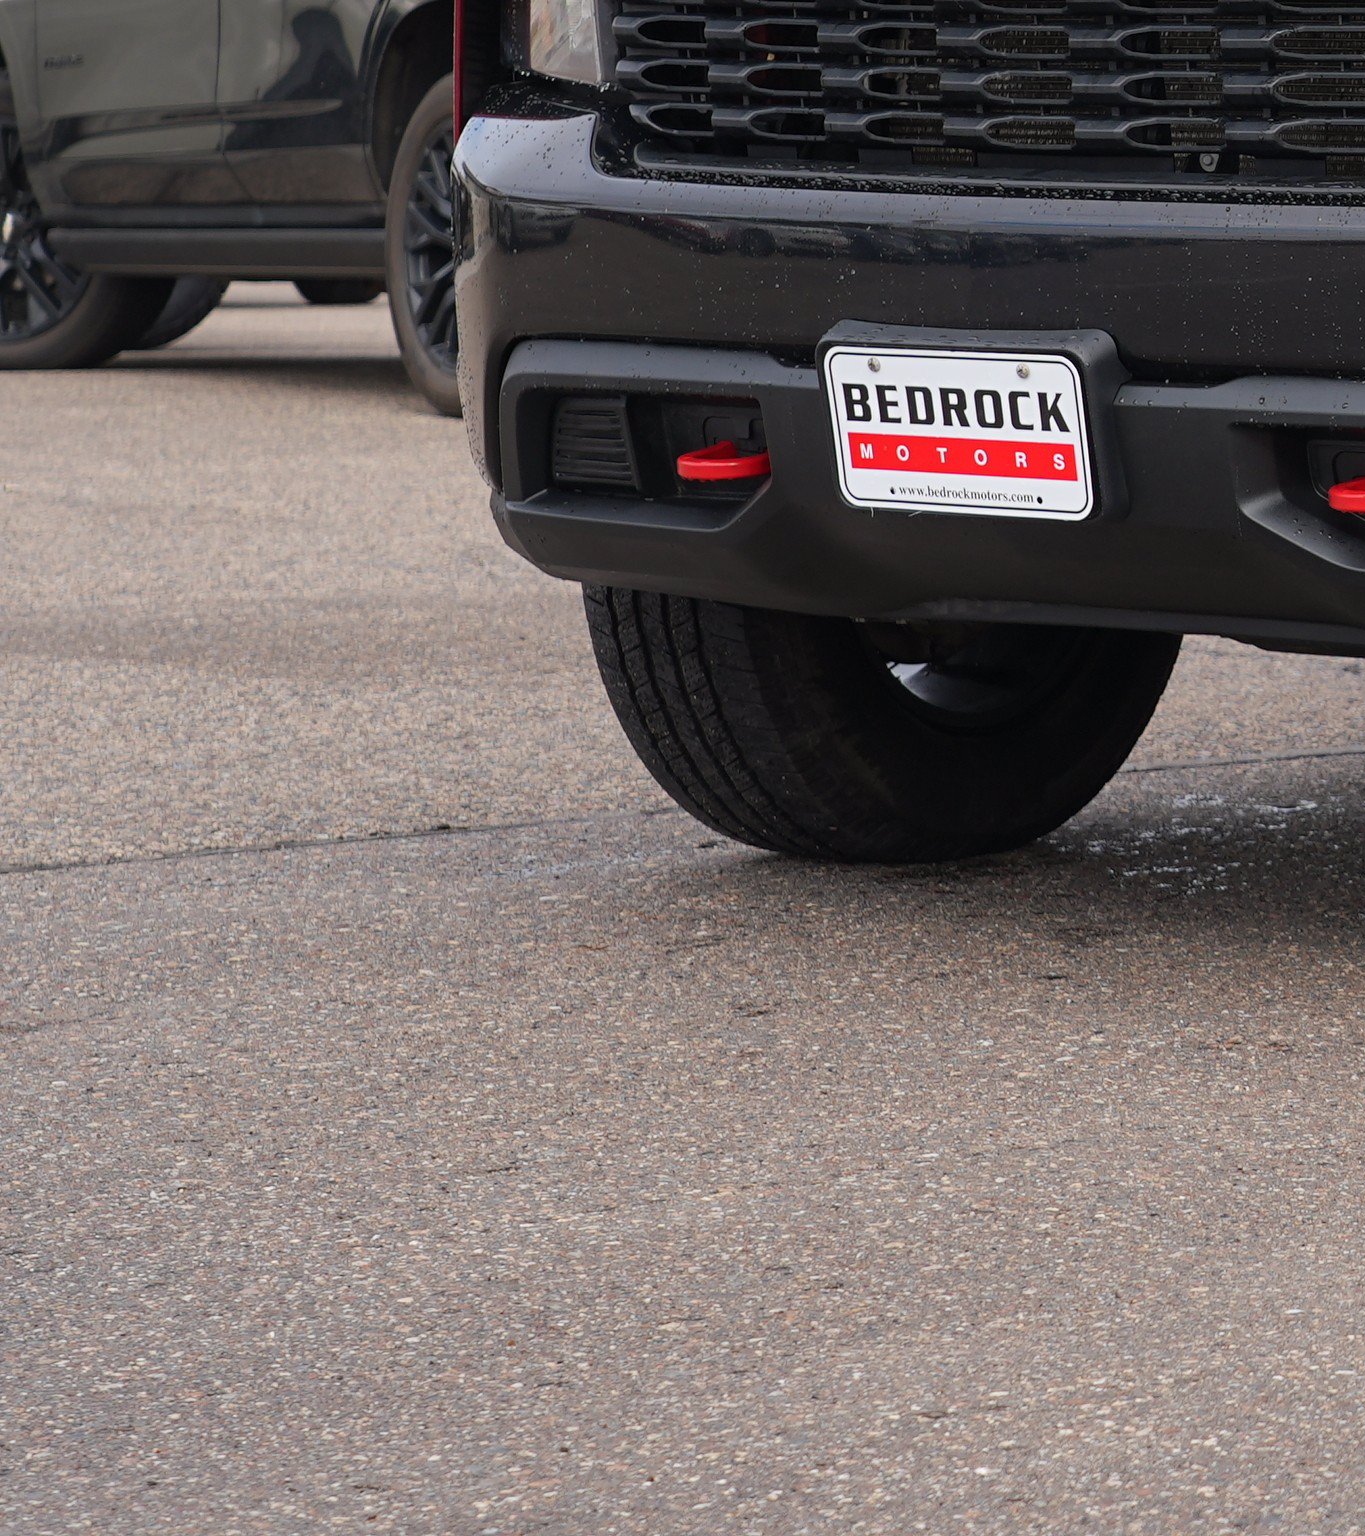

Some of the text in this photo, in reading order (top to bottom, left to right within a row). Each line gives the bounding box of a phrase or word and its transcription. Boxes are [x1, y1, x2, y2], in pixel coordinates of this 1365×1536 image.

[841, 382, 1071, 433] BEDROCK
[859, 442, 1066, 471] MOTORS
[898, 484, 1035, 504] www.bedrockmotors.com
